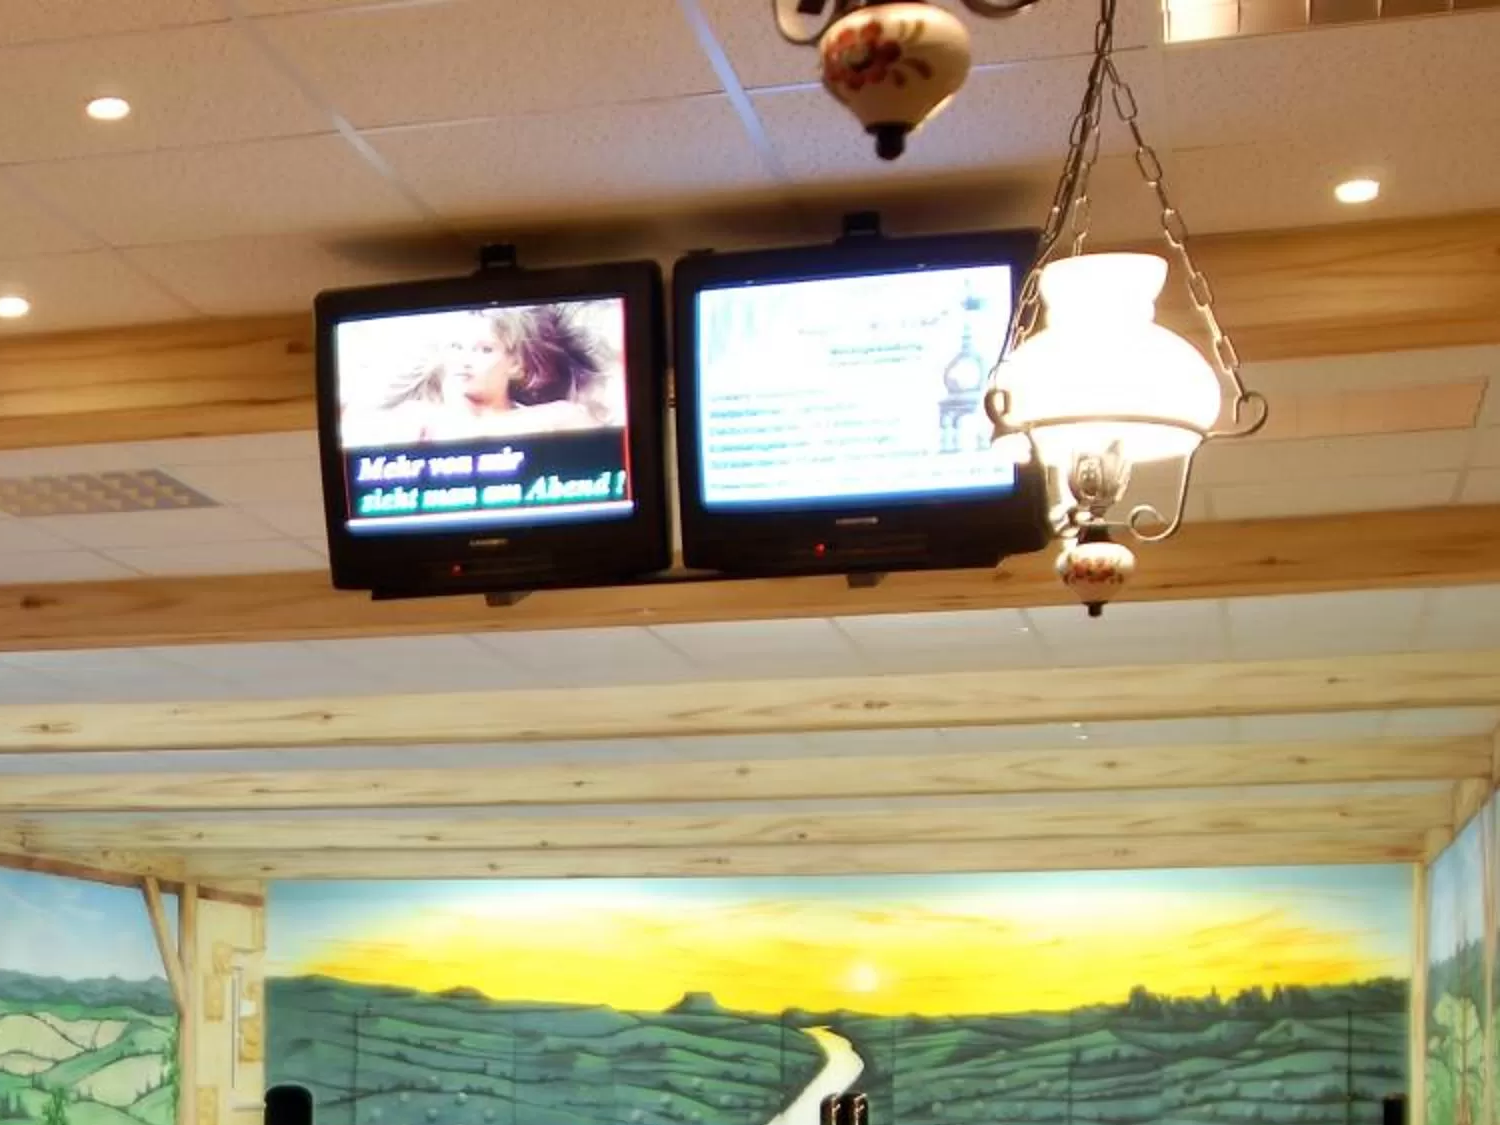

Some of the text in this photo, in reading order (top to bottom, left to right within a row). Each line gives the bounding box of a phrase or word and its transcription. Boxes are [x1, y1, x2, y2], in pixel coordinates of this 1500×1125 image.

[357, 446, 525, 482] Mehr von mir
[361, 487, 419, 514] sieht
[525, 471, 611, 501] Abend
